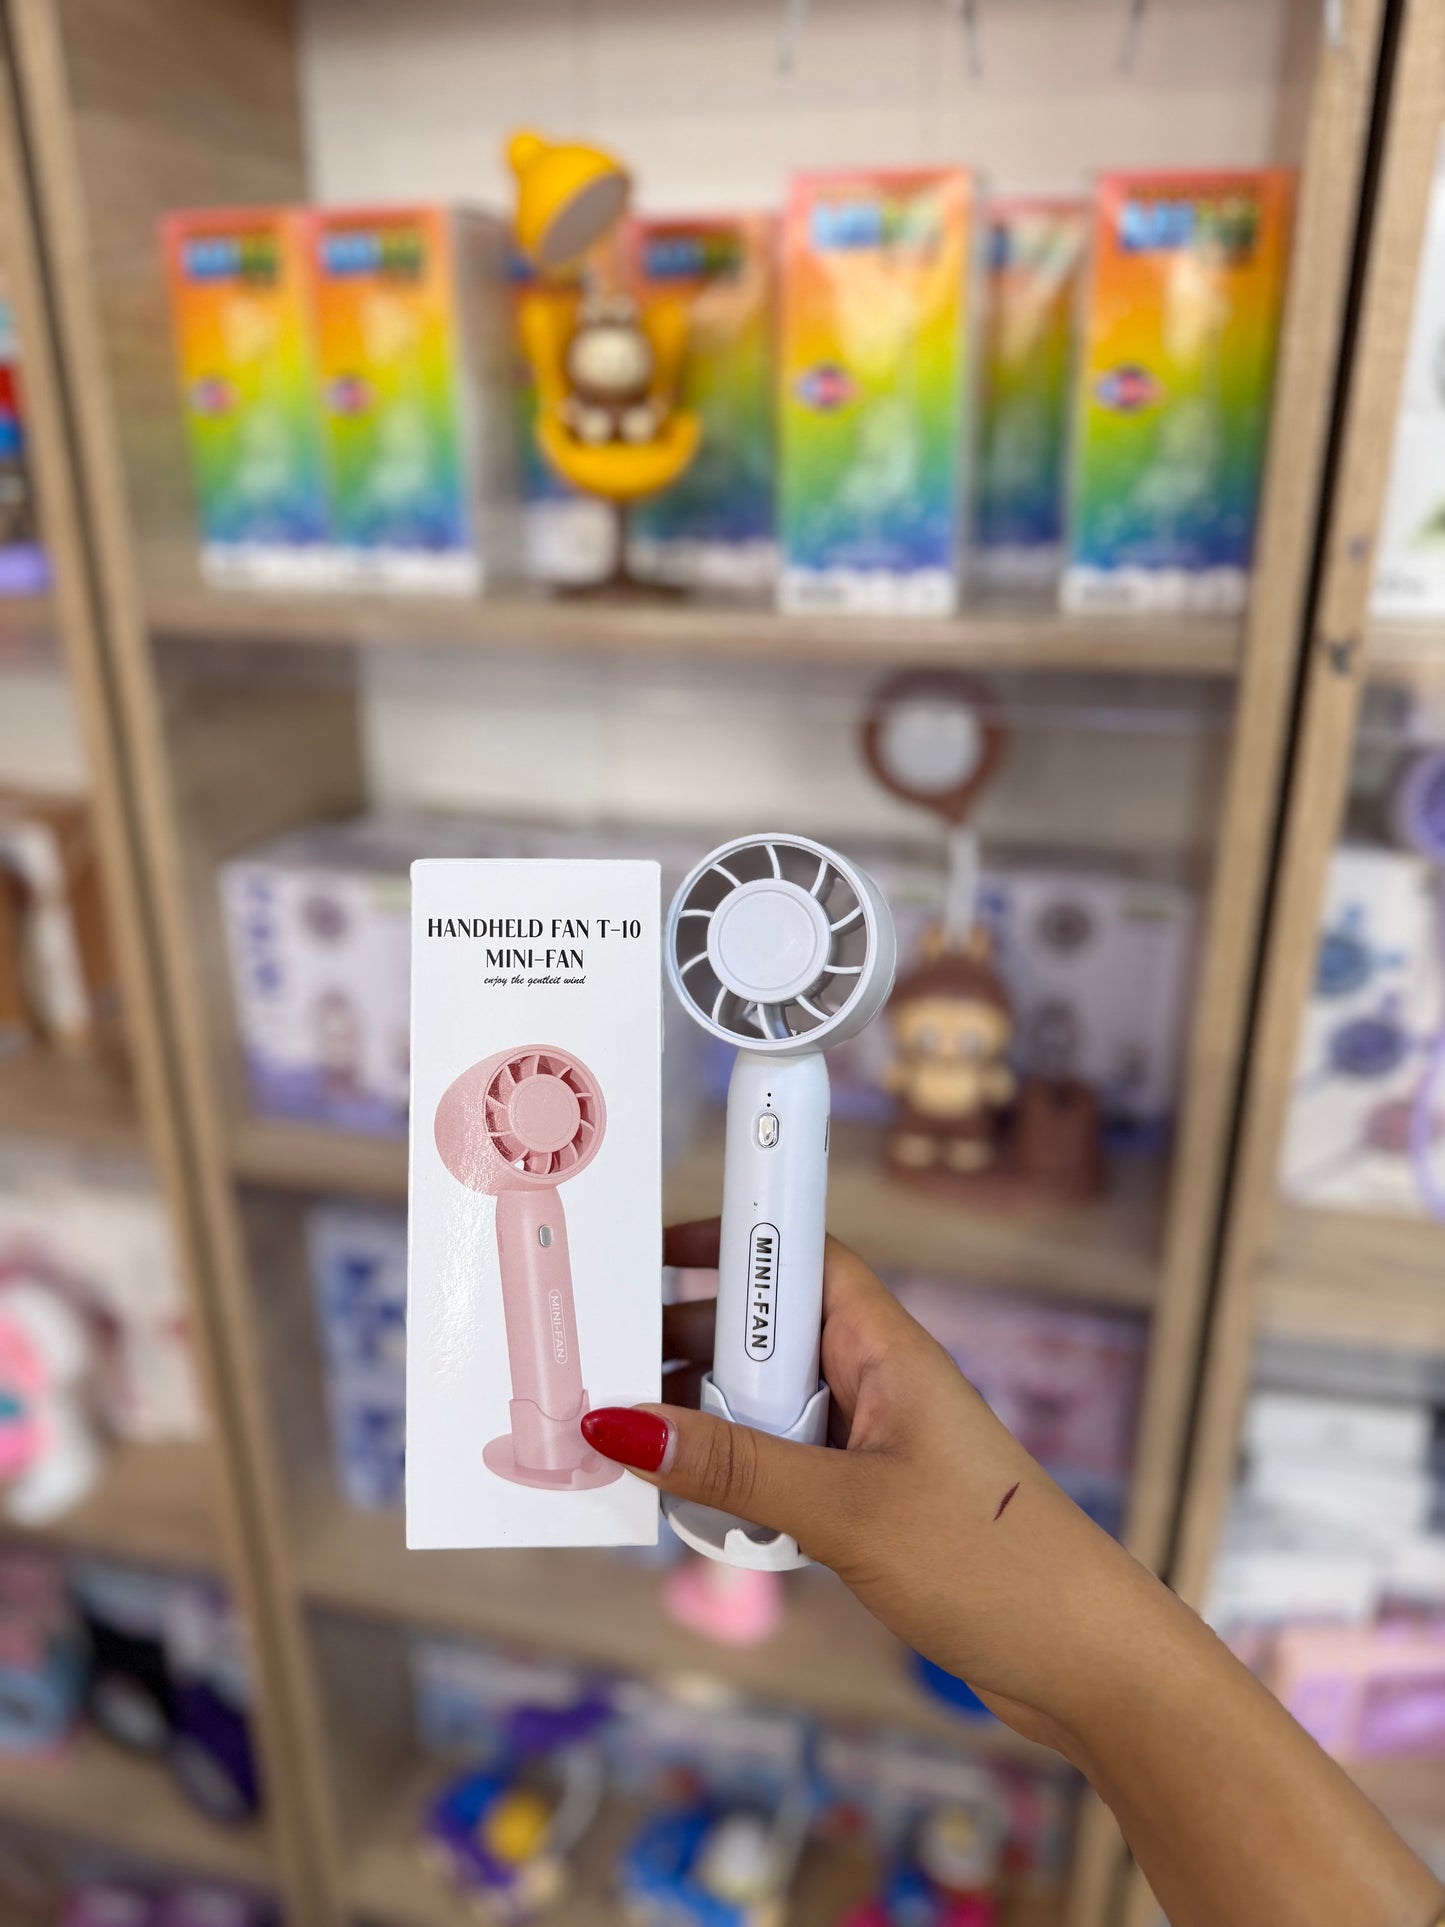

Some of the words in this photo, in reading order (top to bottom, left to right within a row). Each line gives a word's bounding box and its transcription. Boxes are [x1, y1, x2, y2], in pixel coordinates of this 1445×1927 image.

[428, 918, 543, 938] HANDHELD
[551, 919, 589, 939] FAN
[597, 919, 641, 938] T-10
[486, 949, 584, 969] MINI-FAN
[483, 976, 507, 987] enjoy
[511, 974, 524, 985] the
[563, 976, 586, 984] wind
[751, 1236, 773, 1349] MINI-FAN
[550, 1295, 565, 1359] MINI-FAN
